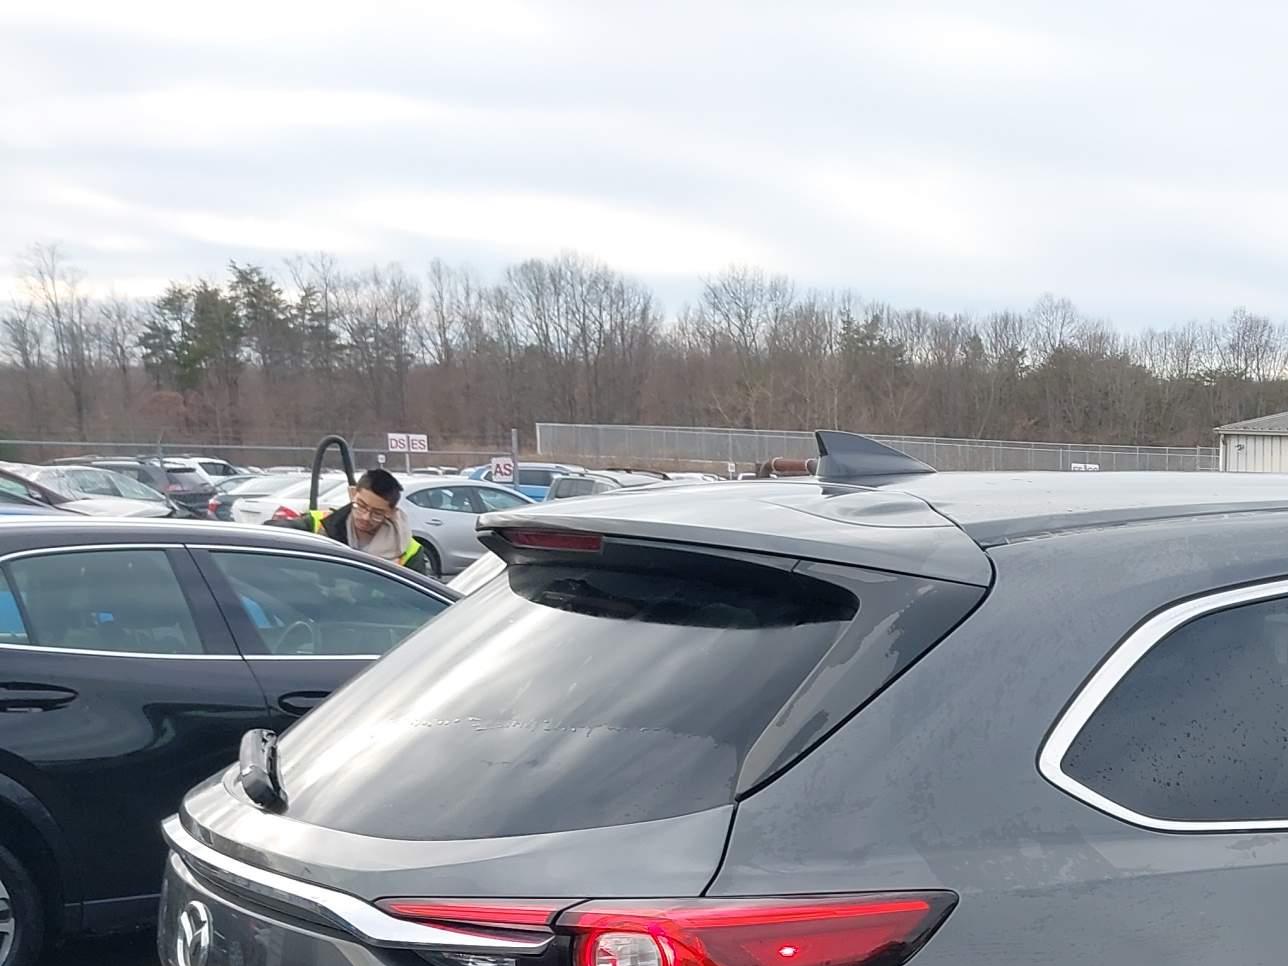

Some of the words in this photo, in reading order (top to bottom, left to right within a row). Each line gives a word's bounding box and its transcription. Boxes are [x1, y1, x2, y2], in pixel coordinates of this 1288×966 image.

[390, 439, 406, 449] DS
[411, 439, 426, 450] ES
[494, 463, 513, 476] AS
